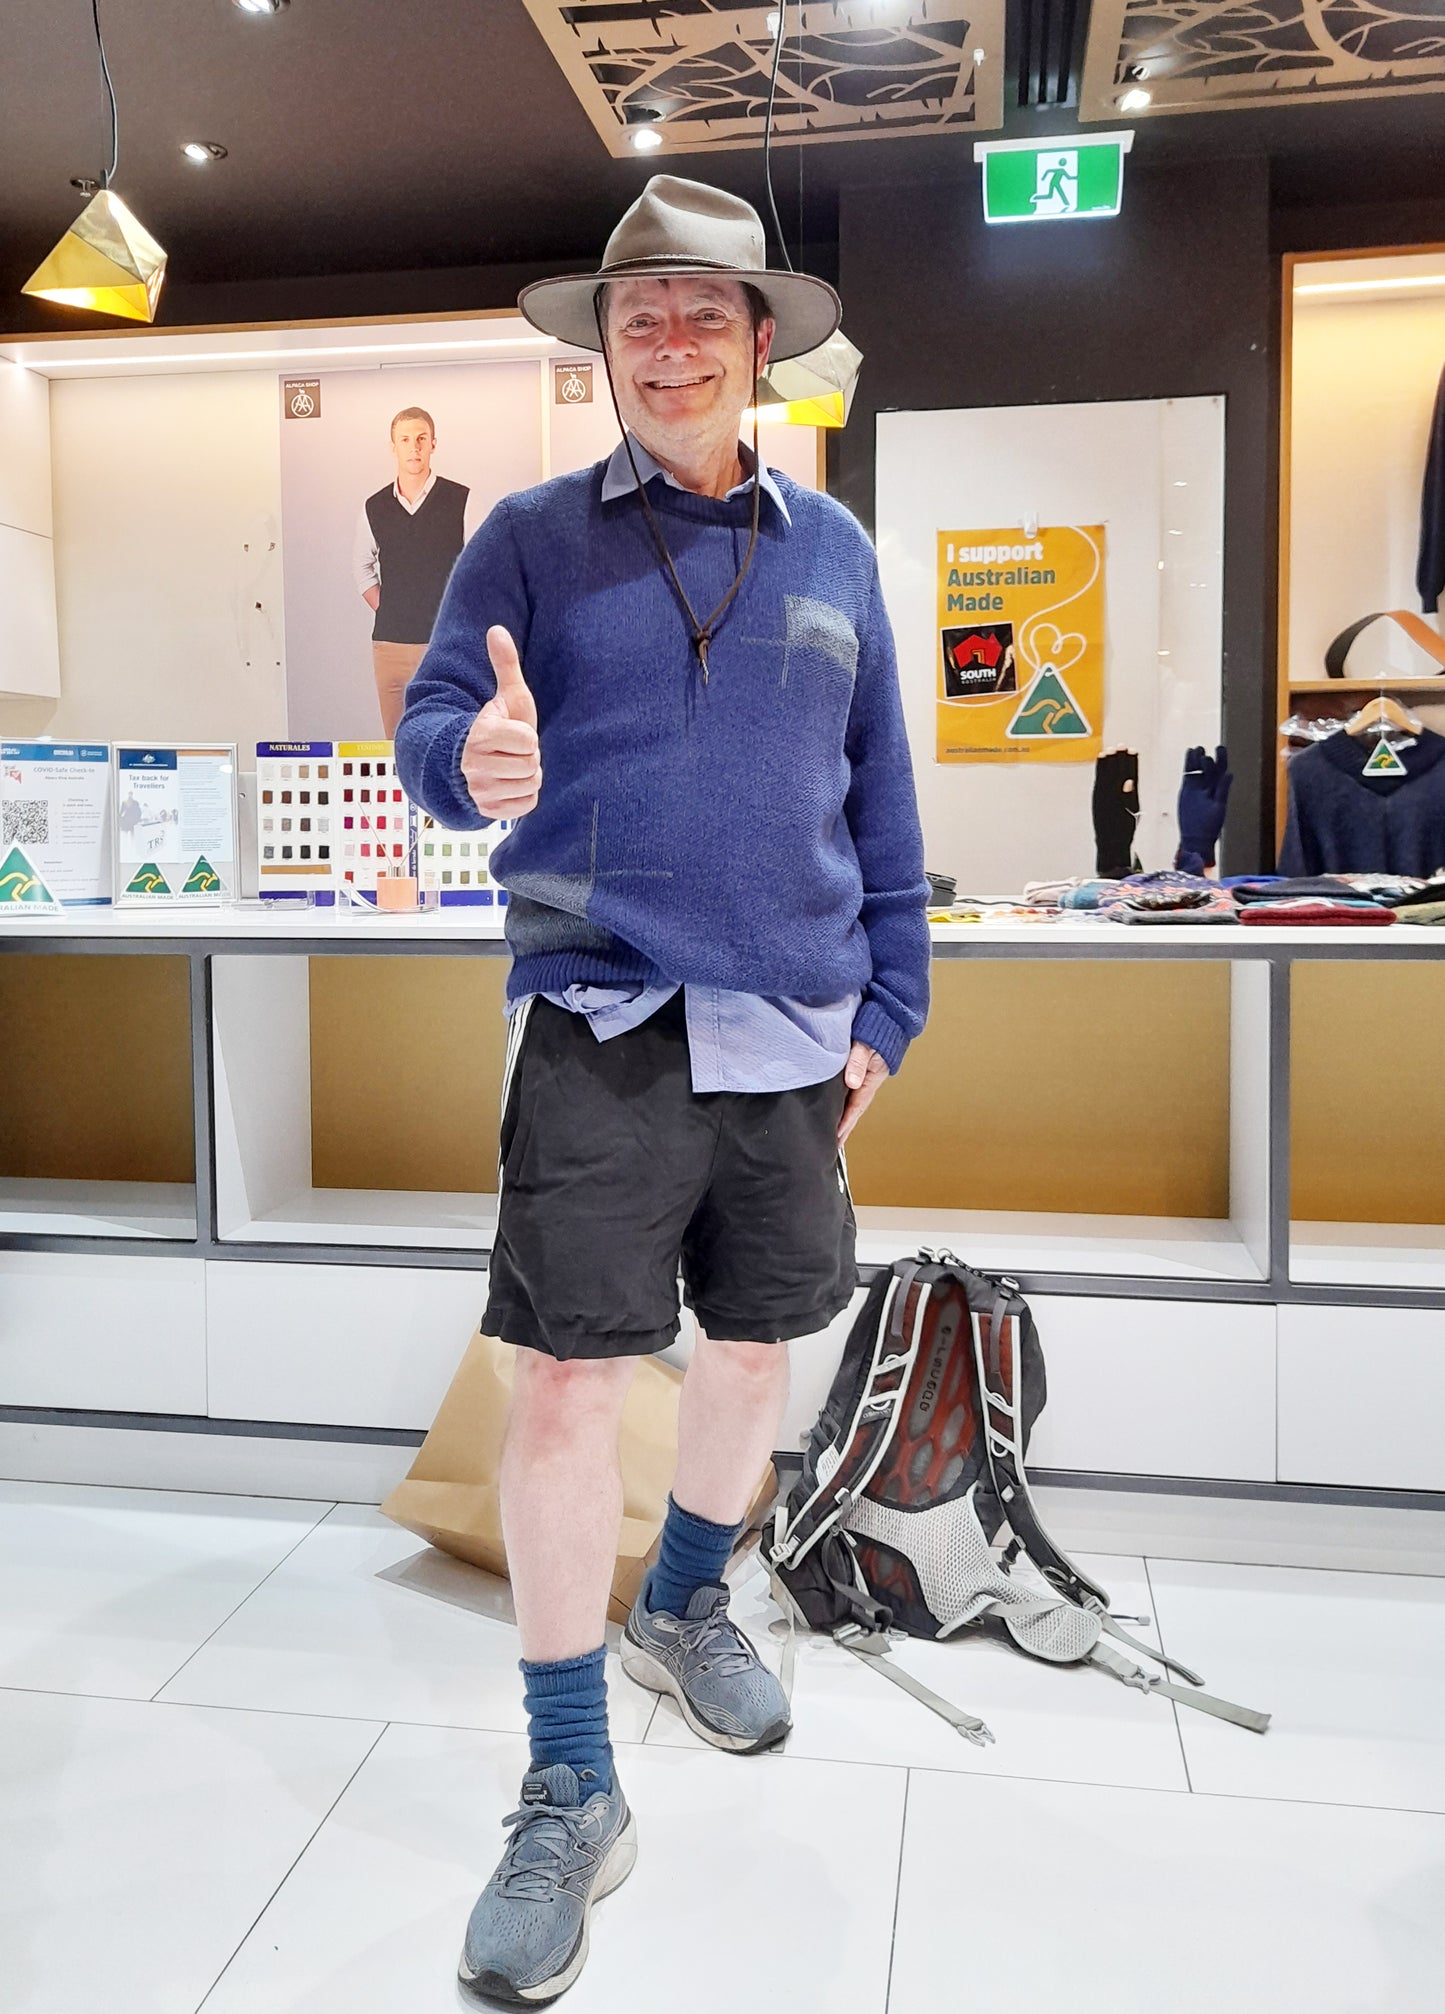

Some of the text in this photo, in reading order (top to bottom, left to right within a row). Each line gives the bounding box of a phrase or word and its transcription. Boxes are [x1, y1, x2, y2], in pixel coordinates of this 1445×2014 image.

[947, 541, 1043, 564] I support
[947, 567, 1056, 587] Australian
[947, 592, 1004, 612] Made
[960, 668, 997, 680] SOUTH
[269, 744, 311, 752] NATURALES
